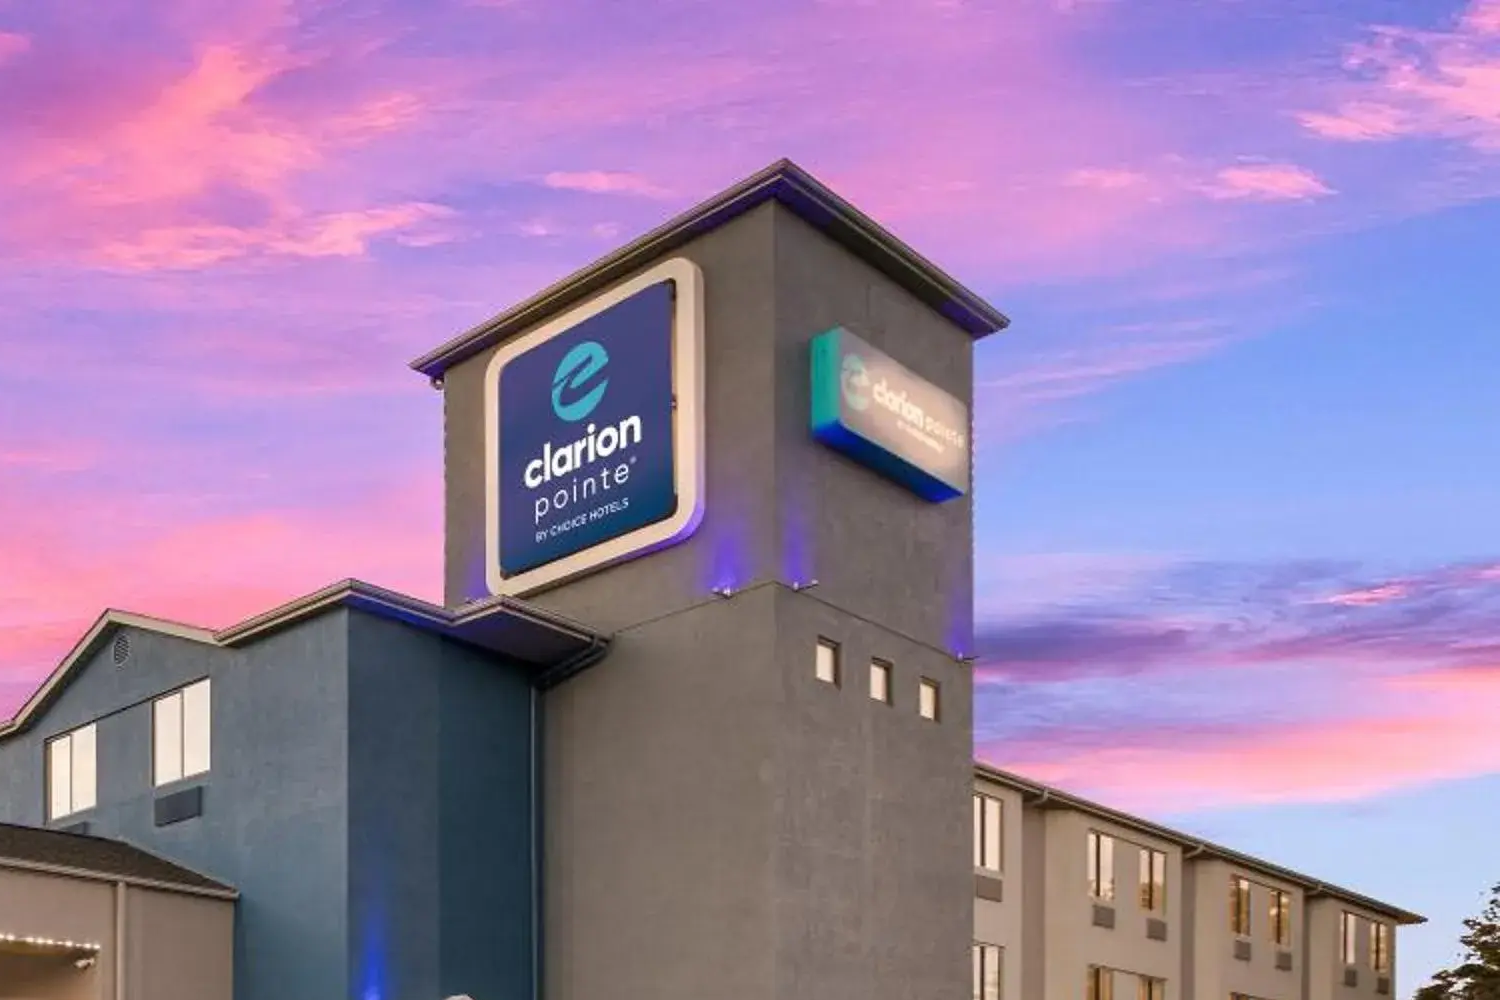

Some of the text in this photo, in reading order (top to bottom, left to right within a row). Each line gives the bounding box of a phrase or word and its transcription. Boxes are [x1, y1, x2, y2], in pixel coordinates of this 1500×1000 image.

[524, 415, 641, 488] clarion
[535, 463, 629, 525] pointe
[535, 497, 629, 543] BY CHOICE HOTELS
